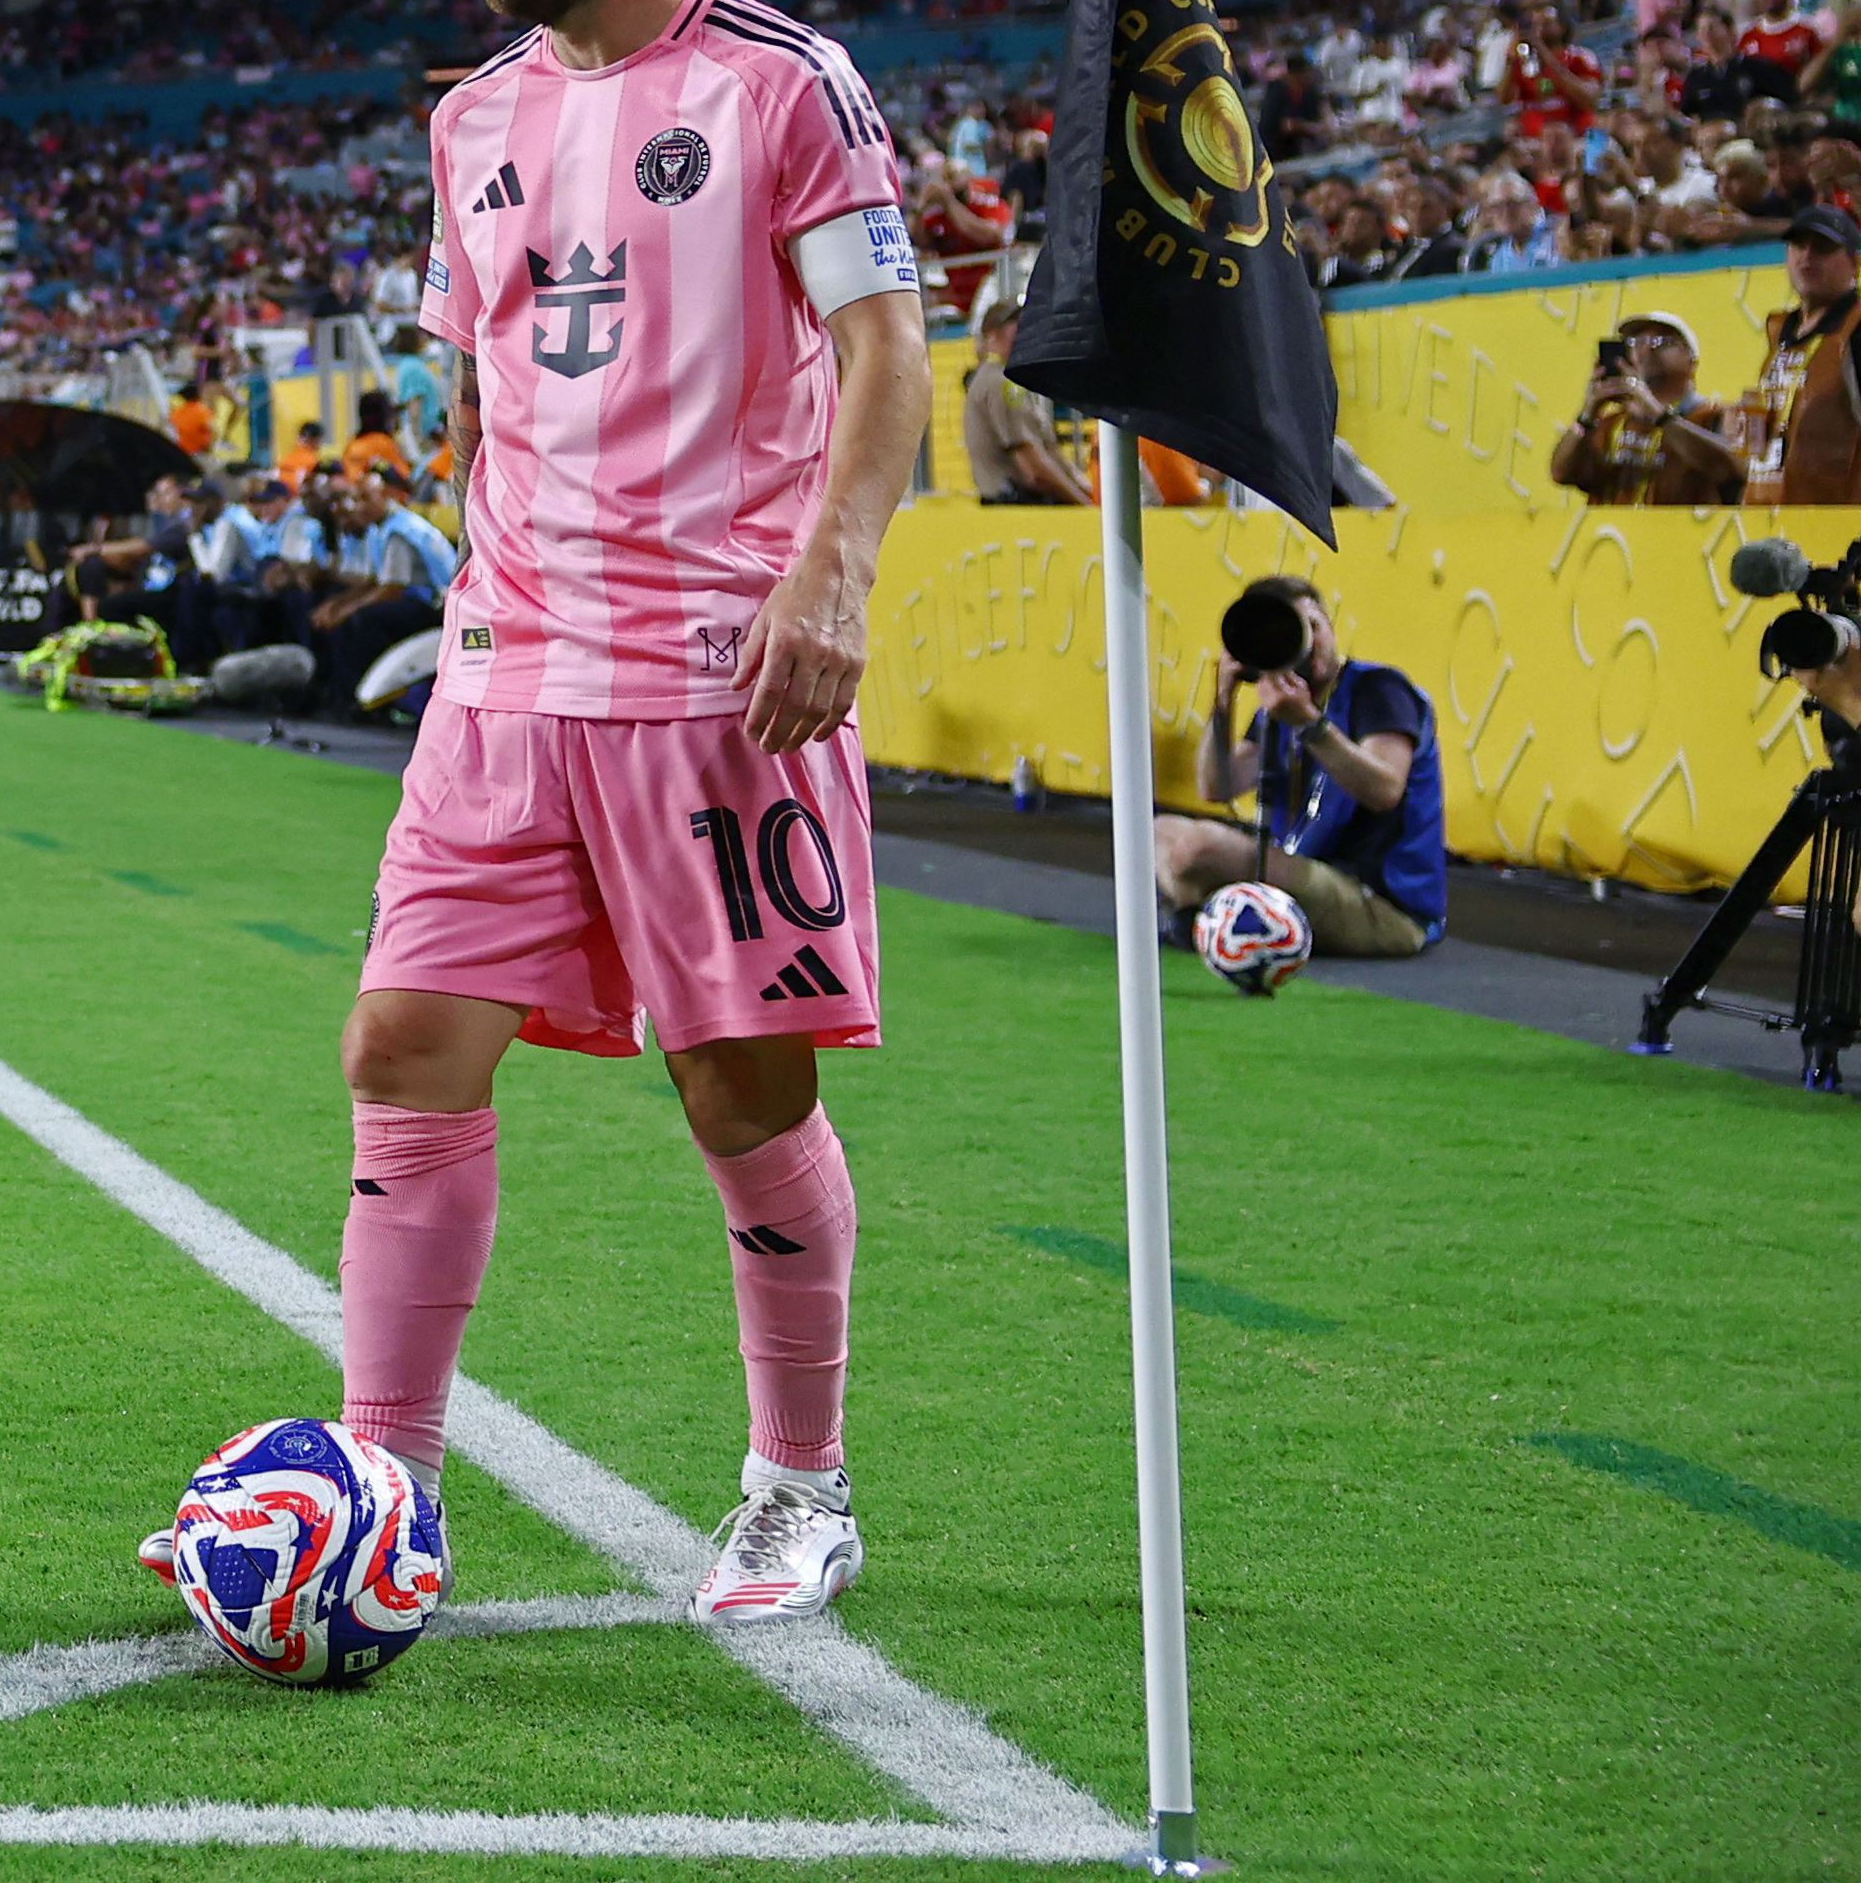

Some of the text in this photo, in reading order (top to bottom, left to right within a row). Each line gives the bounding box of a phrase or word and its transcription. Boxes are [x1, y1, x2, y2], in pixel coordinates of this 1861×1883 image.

[659, 147, 690, 156] MIAMI
[1115, 208, 1241, 289] CLUB
[690, 798, 846, 942] 10
